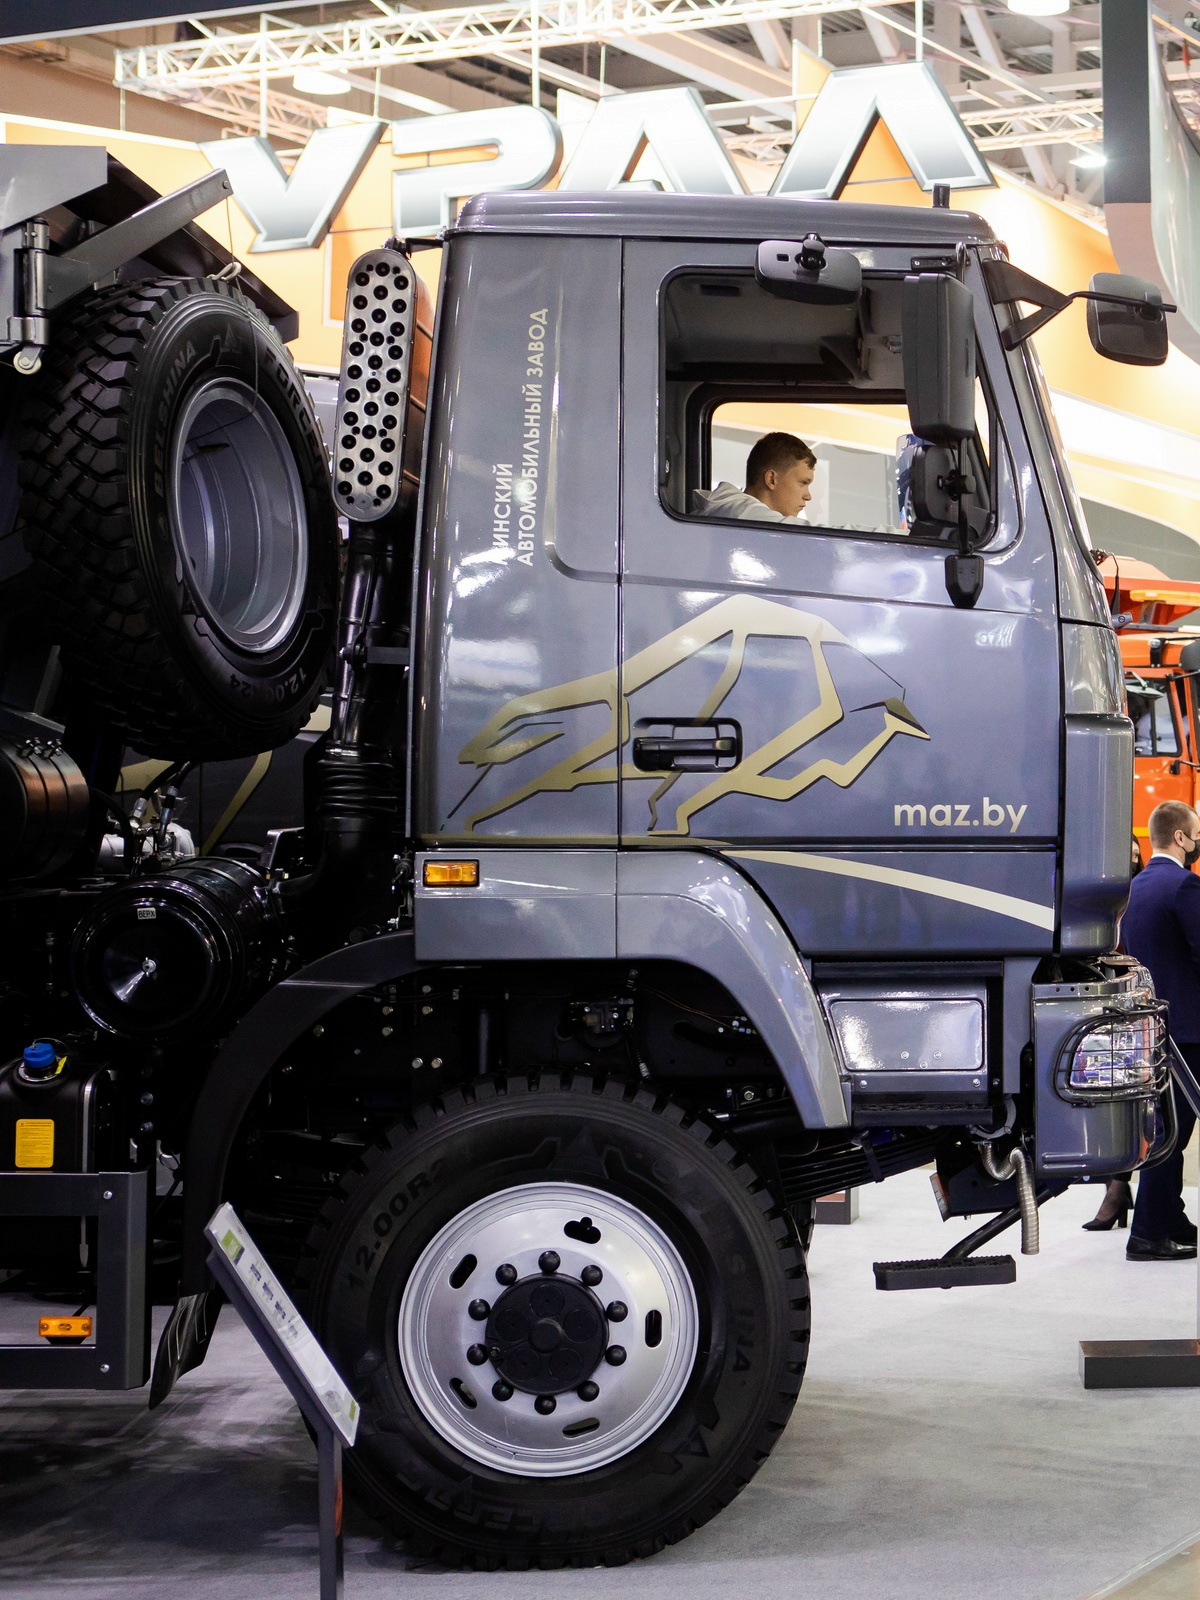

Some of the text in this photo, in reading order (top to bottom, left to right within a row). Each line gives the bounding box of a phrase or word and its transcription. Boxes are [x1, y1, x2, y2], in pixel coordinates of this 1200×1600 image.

[200, 60, 998, 252] УРАЛ
[154, 340, 197, 498] BELSHINA
[517, 308, 549, 567] АВТОМОБИЛЬНЫЙ ЗАВОД
[894, 796, 1028, 833] maz.by
[138, 909, 156, 918] ВЕРХ
[346, 1145, 464, 1290] 12.00R2
